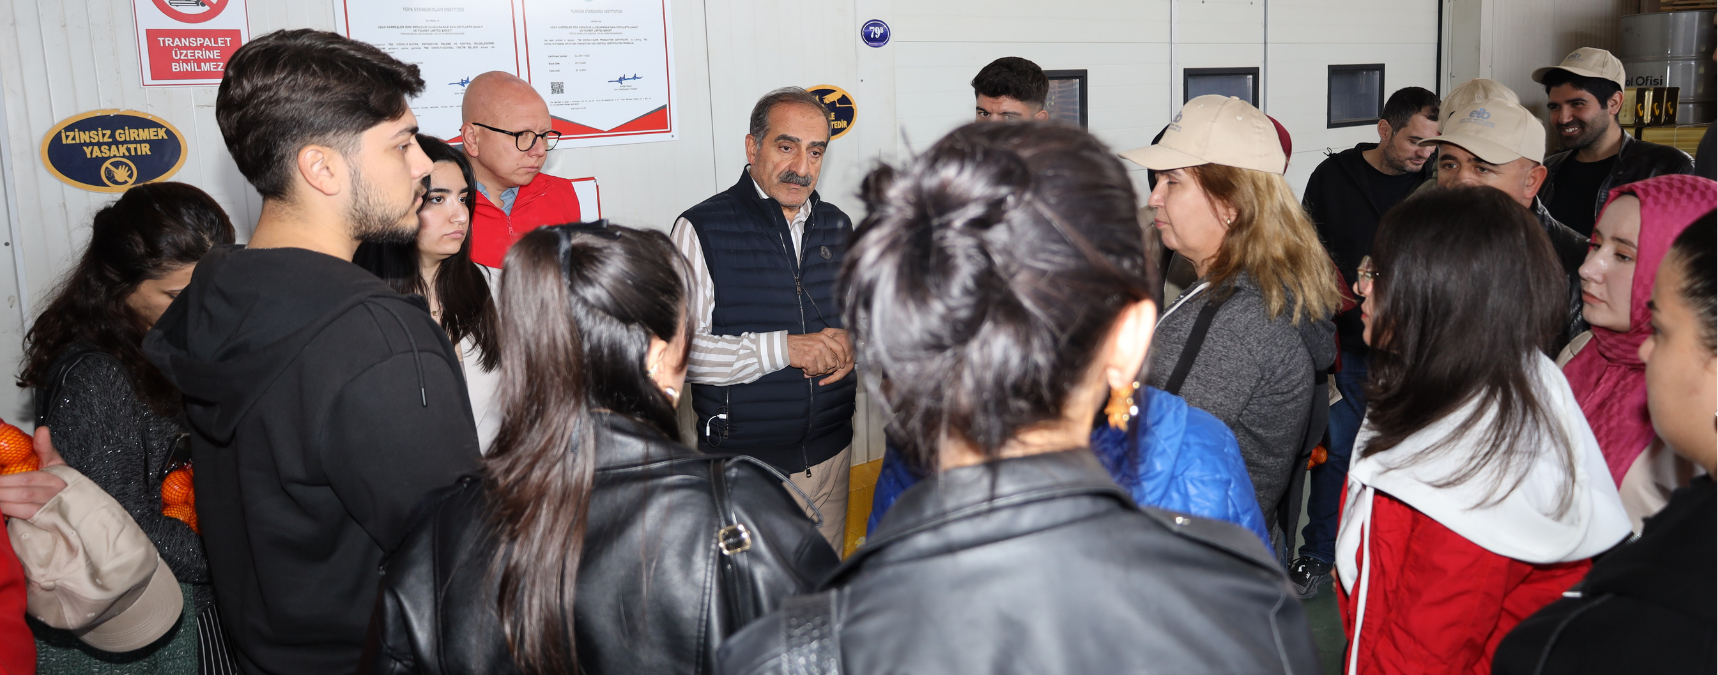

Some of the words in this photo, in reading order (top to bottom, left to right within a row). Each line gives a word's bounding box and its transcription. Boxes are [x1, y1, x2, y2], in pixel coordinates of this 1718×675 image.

[157, 37, 232, 47] TRANSPALET
[172, 48, 221, 60] ÜZERİNE
[171, 61, 225, 72] BİNİLMEZ
[1625, 76, 1633, 86] ol
[1635, 75, 1663, 86] Ofisi
[1469, 107, 1491, 120] eib
[831, 119, 848, 129] TEDİR
[61, 127, 112, 144] İZİNSİZ
[115, 126, 168, 141] GİRMEK
[82, 143, 151, 158] YASAKTIR
